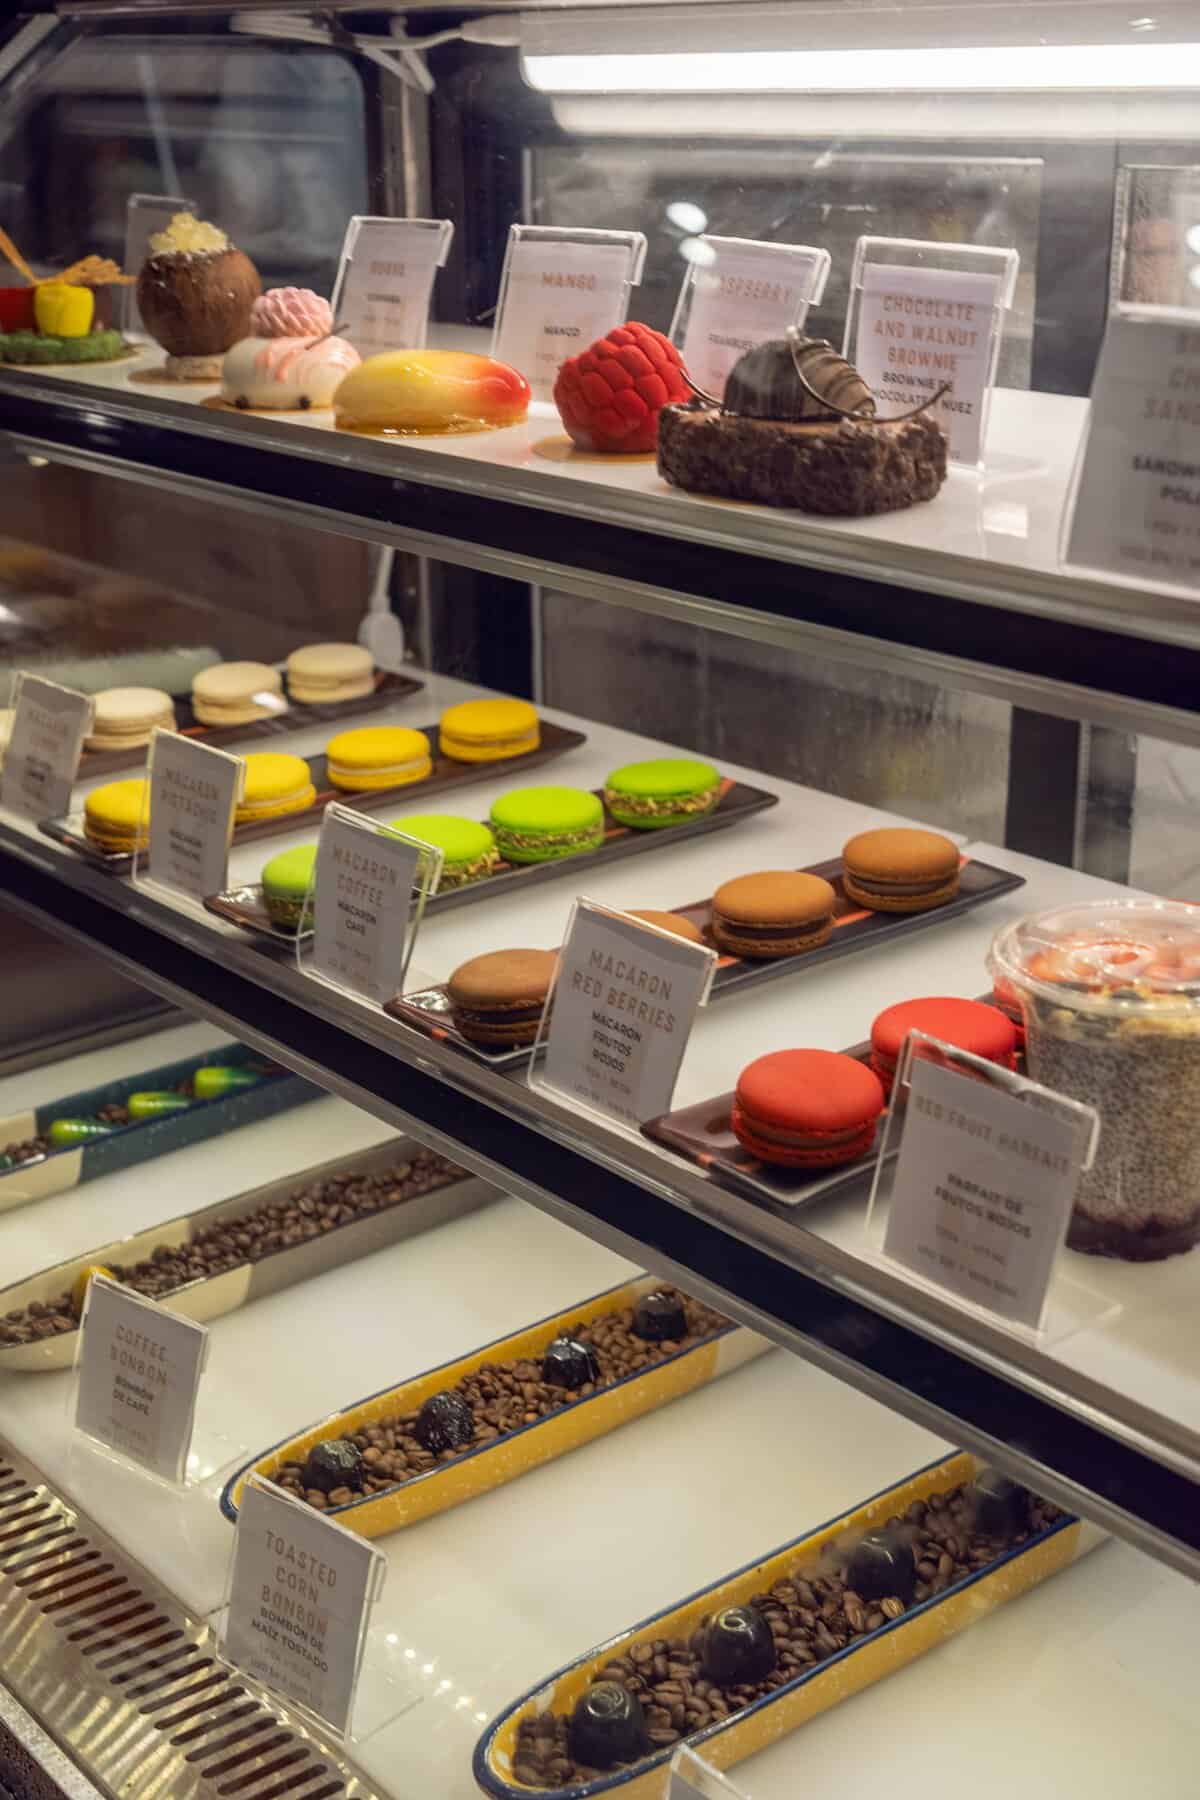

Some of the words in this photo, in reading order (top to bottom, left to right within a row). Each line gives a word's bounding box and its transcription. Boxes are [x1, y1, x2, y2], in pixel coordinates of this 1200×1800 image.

[882, 294, 975, 322] CHOCOLATE
[873, 319, 905, 339] AND
[911, 326, 977, 349] WALNUT
[886, 345, 957, 374] BROWNIE
[881, 370, 938, 391] BROWNIE
[941, 399, 973, 416] NUEZ
[332, 844, 397, 886] MACARON
[336, 872, 384, 908] COFFEE
[588, 948, 674, 1001] MACARON
[570, 968, 604, 999] RED
[605, 985, 676, 1033] BERRIES
[591, 1009, 642, 1042] MACARON
[592, 1028, 633, 1058] FRUTOS
[591, 1047, 627, 1074] ROJOS
[934, 1184, 984, 1218] FRUTOS
[984, 1209, 1033, 1240] ROJOS
[946, 1172, 1000, 1207] PARFAIT
[1002, 1194, 1023, 1216] DE
[114, 1322, 168, 1363] COFFEE
[108, 1343, 167, 1386] BONBON
[265, 1528, 338, 1589] TOASTED
[275, 1564, 319, 1605] CORN
[261, 1583, 329, 1639] BONBON
[281, 1634, 330, 1673] TOSTADO
[309, 1635, 325, 1654] DE
